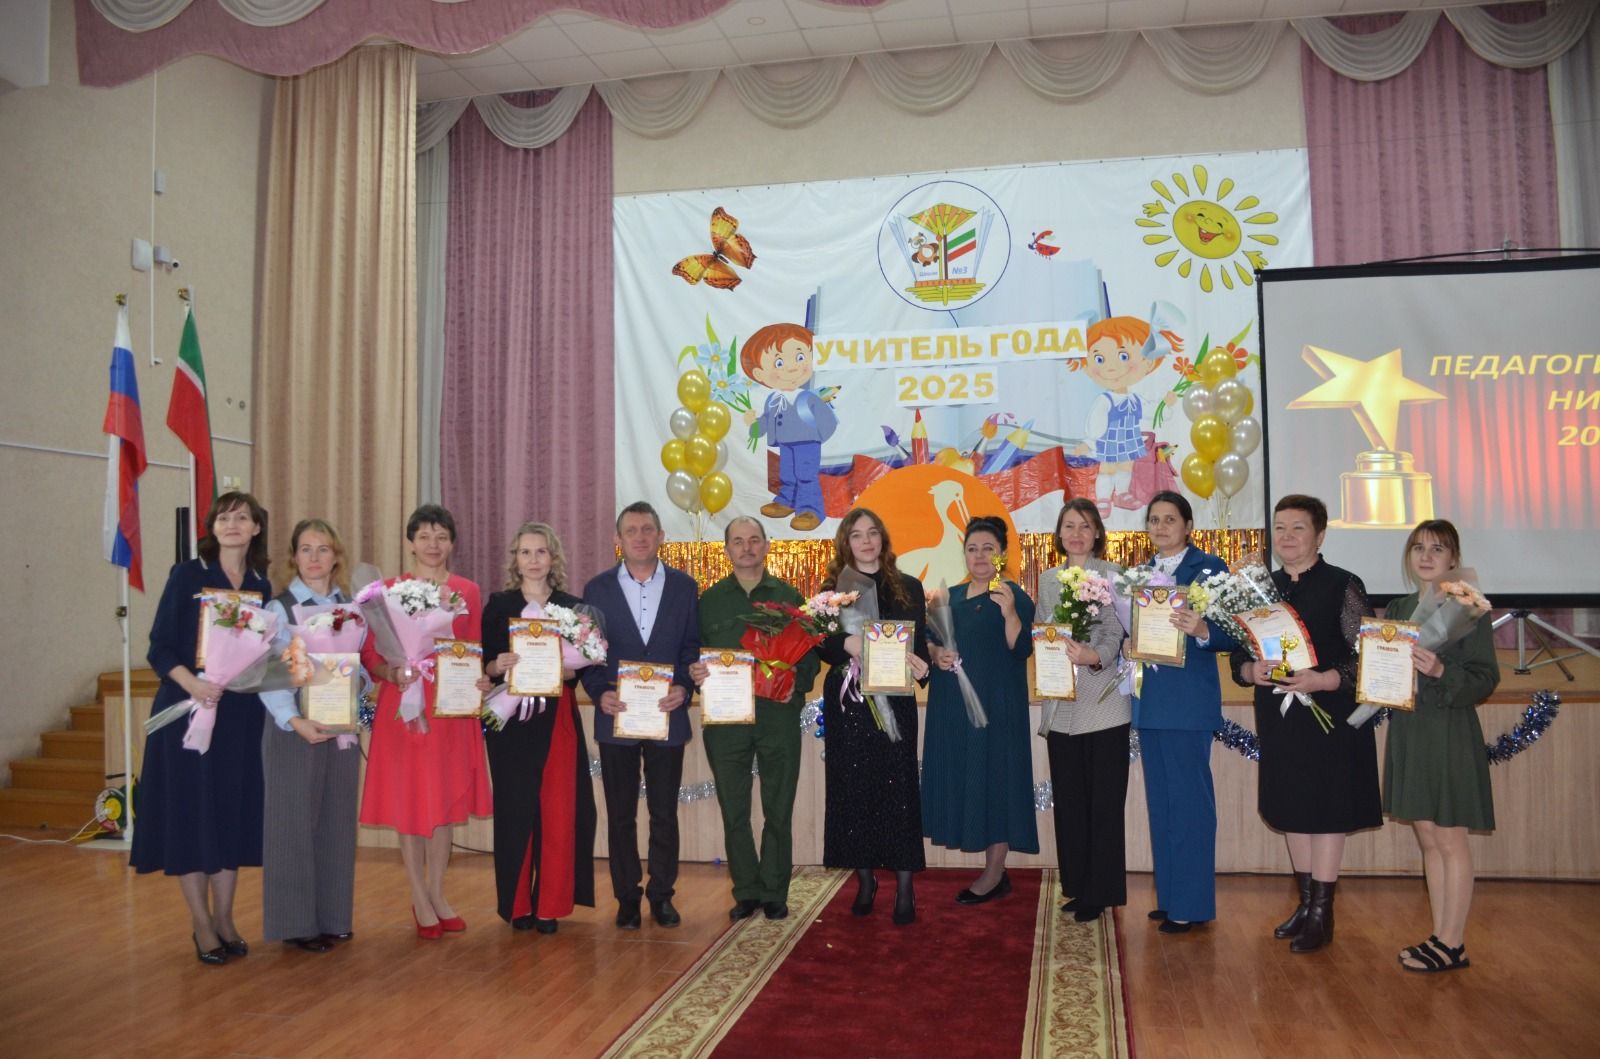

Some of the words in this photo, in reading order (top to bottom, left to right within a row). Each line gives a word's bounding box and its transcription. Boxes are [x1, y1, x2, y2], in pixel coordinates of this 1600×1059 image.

[815, 335, 982, 365] УЧИТЕЛЬ
[990, 328, 1086, 356] ГОДА
[898, 372, 995, 401] 2025
